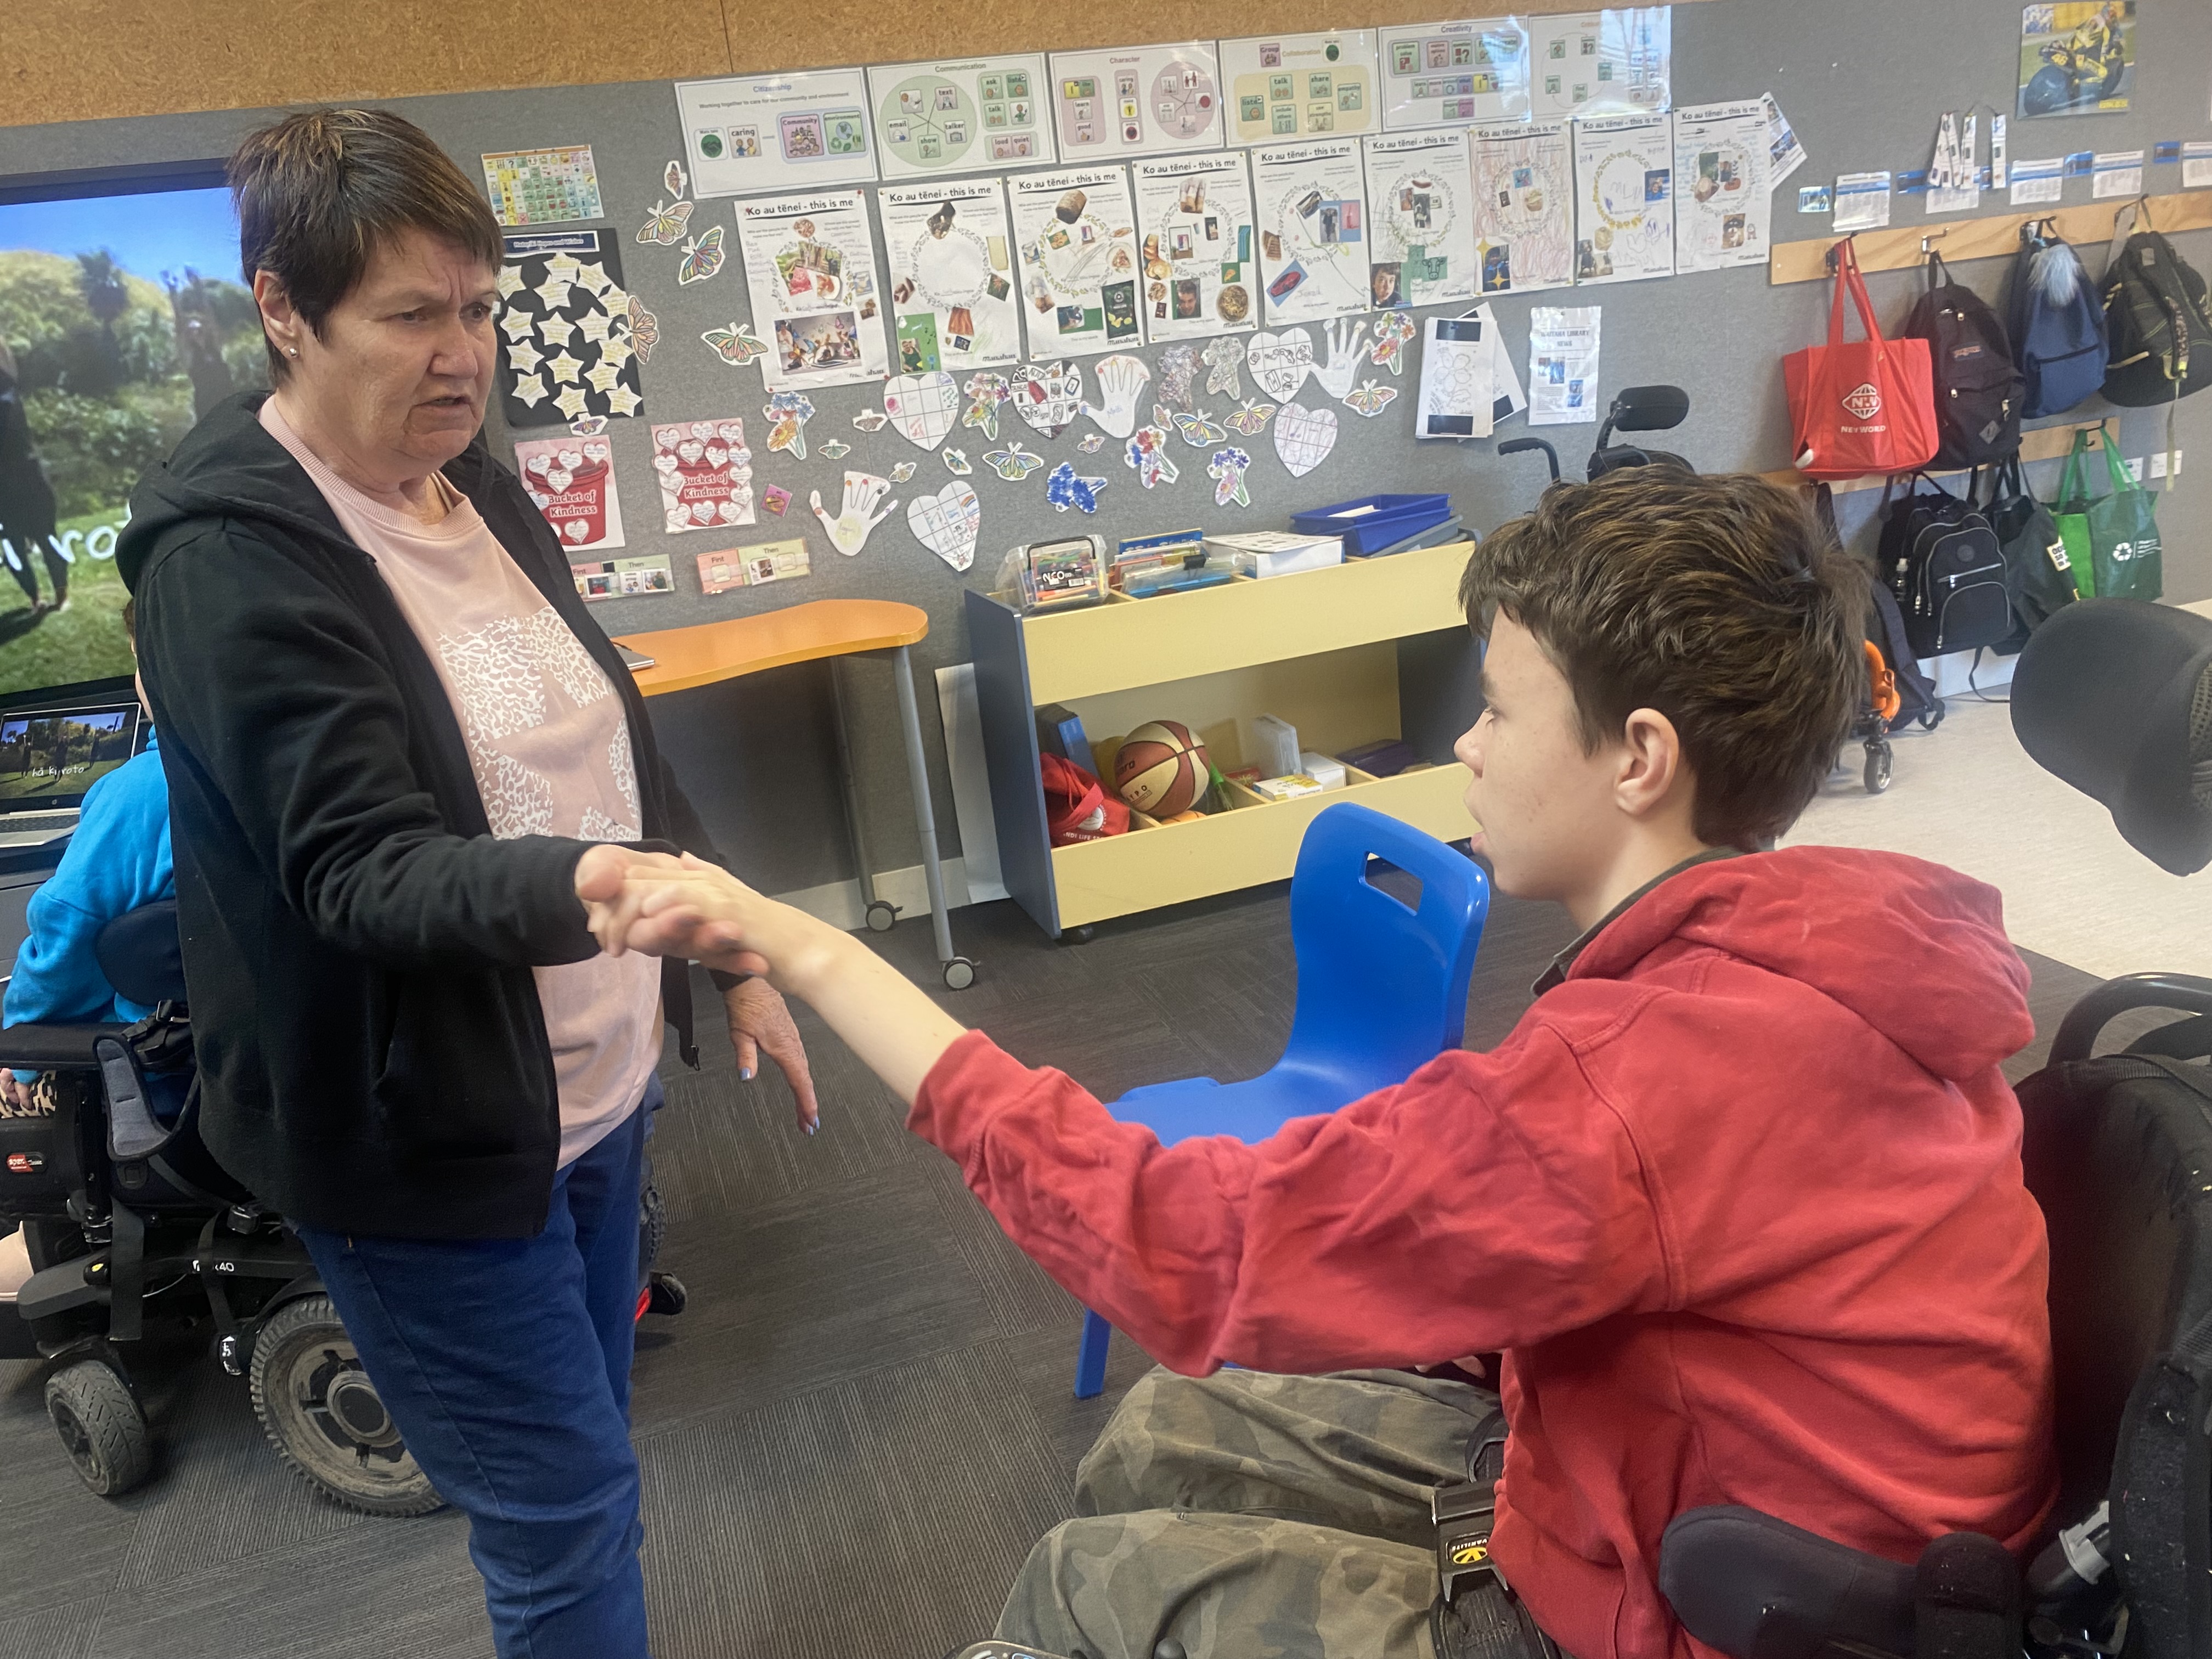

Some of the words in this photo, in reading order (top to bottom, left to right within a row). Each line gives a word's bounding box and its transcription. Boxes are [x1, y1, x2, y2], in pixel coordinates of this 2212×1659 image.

[935, 63, 986, 72] Communication
[753, 84, 792, 93] Citizenship
[1077, 123, 1091, 132] good
[731, 128, 755, 137] caring
[1424, 136, 1437, 144] this
[1314, 147, 1328, 156] this
[1143, 166, 1155, 174] Ko
[1199, 160, 1213, 168] this
[1019, 181, 1031, 189] Ko
[1076, 174, 1092, 183] this
[889, 194, 903, 202] Ko
[950, 188, 966, 196] this
[747, 207, 760, 216] Ko
[810, 200, 827, 209] this
[685, 474, 715, 485] Bucket
[718, 472, 727, 483] of
[685, 487, 729, 498] Kindness
[549, 493, 582, 504] Bucket
[585, 491, 596, 502] of
[551, 506, 596, 516] Kindness
[763, 546, 780, 555] Then
[711, 555, 725, 563] First
[572, 567, 586, 575] First
[49, 766, 57, 775] ki
[61, 764, 84, 775] roto
